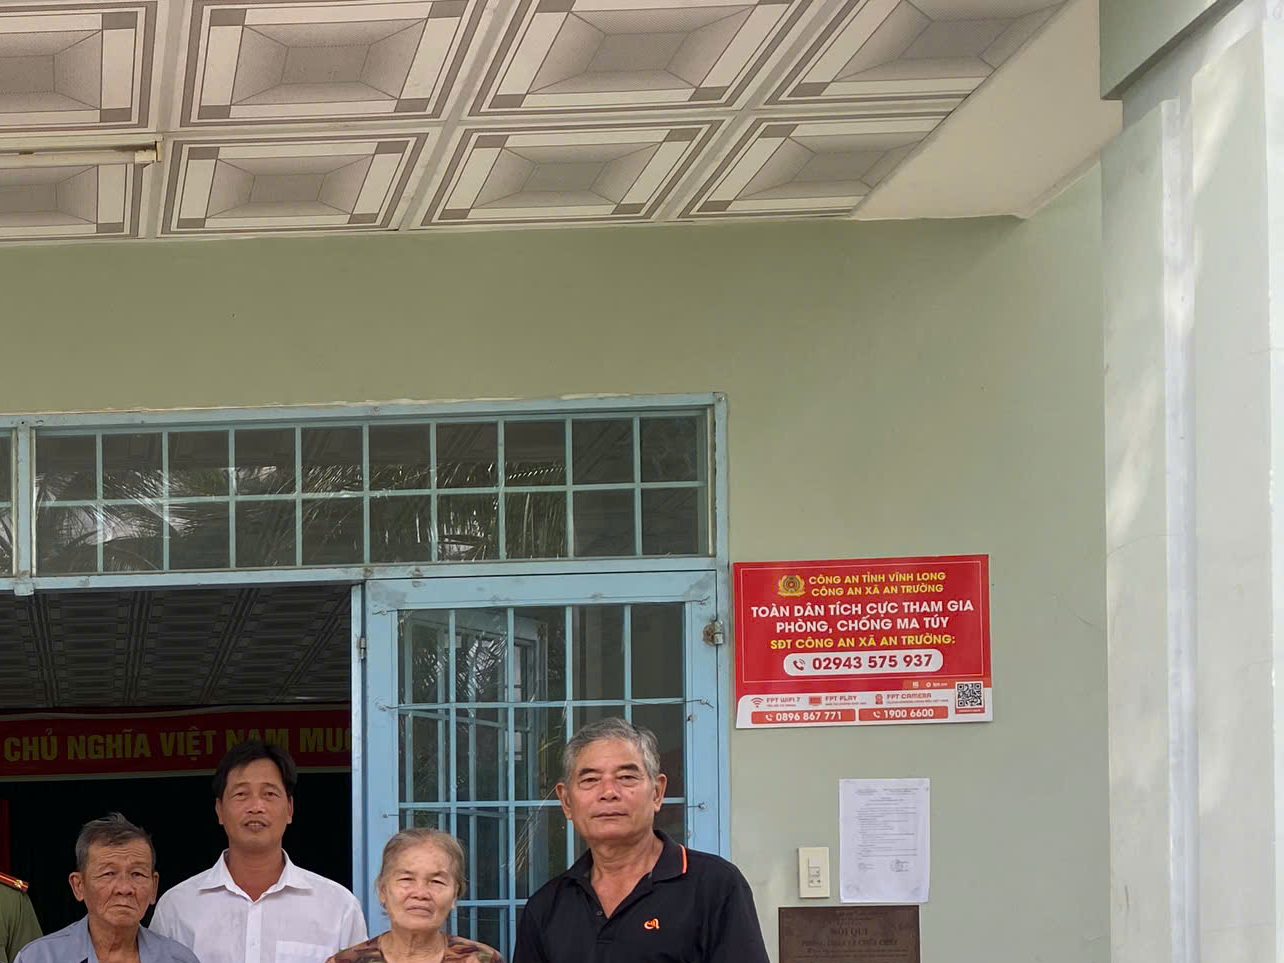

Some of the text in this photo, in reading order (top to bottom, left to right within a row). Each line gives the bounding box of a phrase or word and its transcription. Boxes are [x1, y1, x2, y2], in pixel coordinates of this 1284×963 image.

[808, 571, 946, 585] CÔNG AN TỈNH VĨNH LONG
[811, 583, 944, 597] CÔNG AN XÃ AN TRƯỜNG
[751, 600, 974, 618] TOÀN DÂN TÍCH CỰC THAM GIA
[776, 614, 949, 634] PHÒNG, CHỐNG MA TÚY
[770, 632, 956, 649] SĐT CÔNG AN XÃ AN TRƯỜNG:
[812, 654, 933, 670] 02943 575 937
[776, 711, 842, 721] 0896 867 771
[884, 708, 934, 718] 1900 6600
[4, 728, 58, 762] CHỦ
[67, 728, 152, 761] NGHĨA
[160, 726, 216, 761] VIỆT
